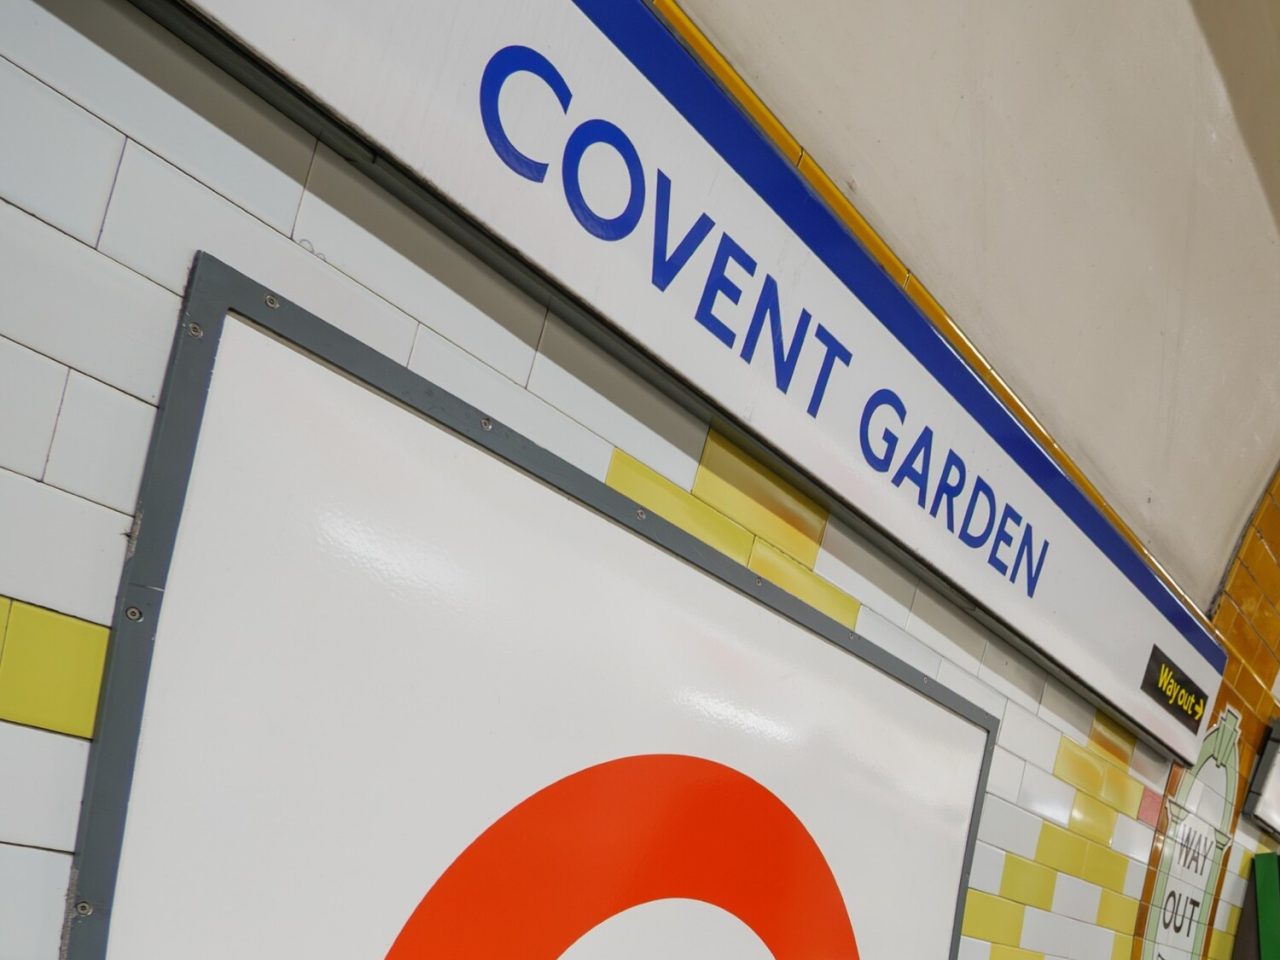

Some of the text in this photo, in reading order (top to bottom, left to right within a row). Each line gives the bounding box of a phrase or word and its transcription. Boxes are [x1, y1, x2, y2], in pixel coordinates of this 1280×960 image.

[479, 45, 1050, 599] COVENT GARDEN
[1158, 663, 1196, 715] Way out
[1177, 824, 1214, 877] WAY
[1162, 890, 1200, 938] OUT
